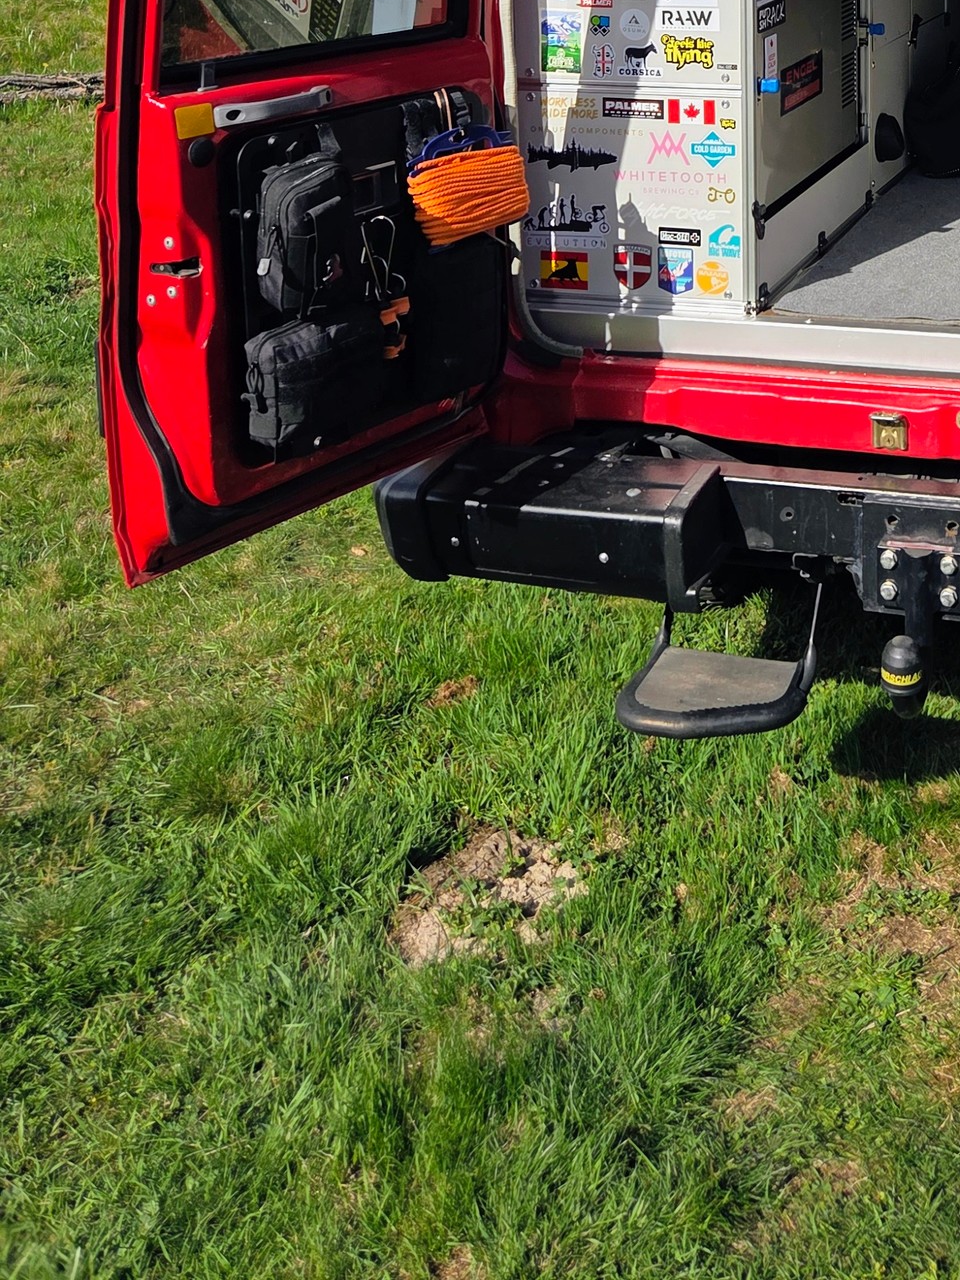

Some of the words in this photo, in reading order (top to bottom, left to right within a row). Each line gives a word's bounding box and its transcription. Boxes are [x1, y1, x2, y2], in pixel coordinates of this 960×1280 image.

[662, 10, 713, 26] RAAW
[665, 48, 714, 70] flying
[618, 68, 662, 77] CORSICA
[786, 59, 818, 83] ENGEL
[541, 98, 567, 107] WORK
[570, 98, 596, 107] LESS
[605, 101, 660, 112] PALMER
[541, 108, 567, 119] RIDE
[570, 108, 599, 120] MORE
[570, 126, 644, 137] COMPONENTS
[694, 145, 709, 153] COLD
[614, 170, 727, 184] WHITETOOTH
[642, 187, 686, 195] BREWING
